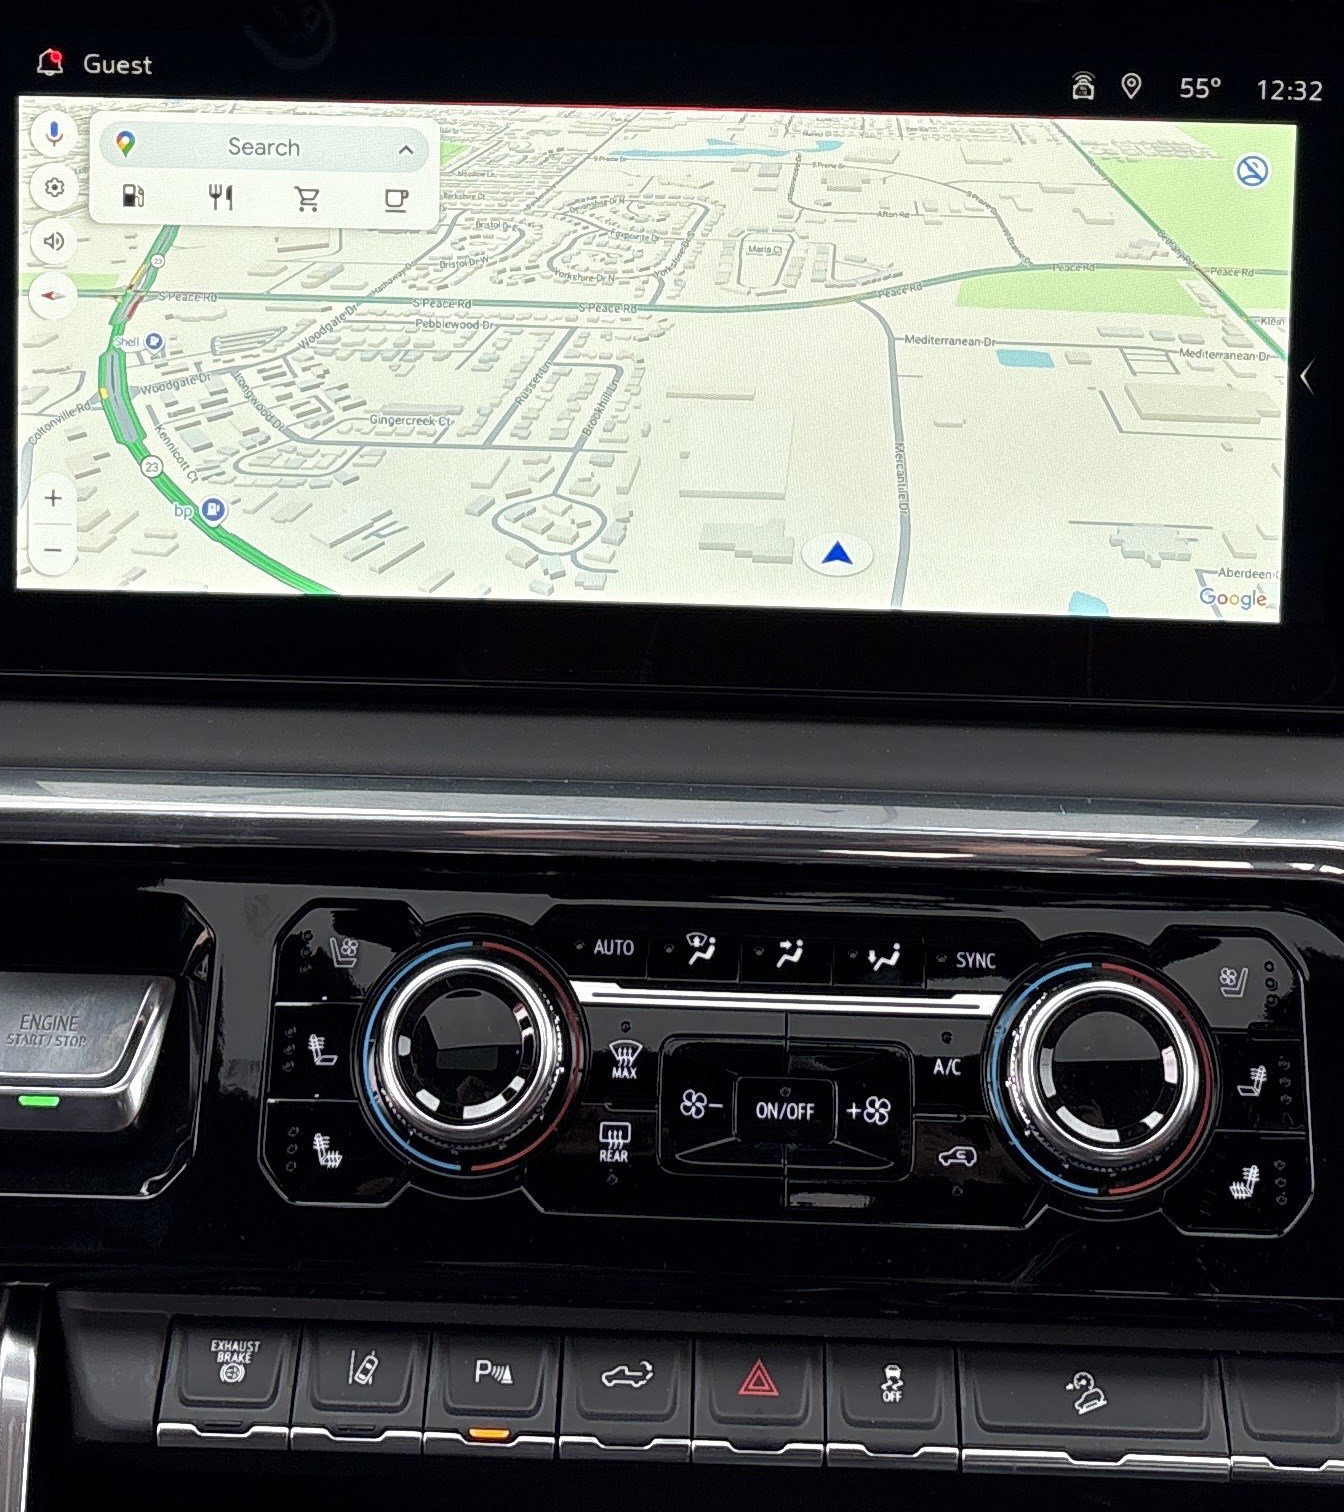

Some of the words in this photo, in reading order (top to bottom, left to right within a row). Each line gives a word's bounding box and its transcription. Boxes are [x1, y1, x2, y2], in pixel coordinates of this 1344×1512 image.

[83, 53, 153, 75] Guest
[1180, 77, 1222, 98] 55°
[1257, 79, 1323, 102] 12:32
[228, 136, 301, 157] Search
[1052, 263, 1082, 272] Peace
[1083, 262, 1096, 272] Rd
[1210, 268, 1240, 277] Peace
[1241, 268, 1255, 277] Rd
[158, 292, 165, 301] S
[168, 292, 200, 302] Peace
[202, 293, 217, 303] Rd
[877, 285, 907, 299] Peace
[908, 282, 923, 292] Rd
[412, 298, 421, 308] S
[422, 298, 455, 309] Peace
[457, 299, 472, 309] Rd
[579, 303, 587, 313] S
[590, 303, 621, 313] Peace
[623, 304, 637, 314] Rd
[297, 314, 346, 350] Woodgate
[344, 303, 358, 316] Dr
[415, 318, 480, 330] Pebblewood
[483, 320, 495, 330] Dr
[1260, 317, 1285, 326] Klein
[114, 337, 140, 347] Shell
[904, 334, 981, 347] Mediterranean
[983, 337, 996, 347] Dr
[1179, 348, 1256, 362] Mediterranean
[1258, 351, 1271, 362] Dr
[140, 375, 197, 396] Woodgate
[198, 373, 212, 384] Dr
[515, 374, 544, 406] Russet
[235, 373, 276, 425] Longwood
[369, 414, 436, 427] Gingercreek
[438, 416, 451, 428] Ct
[582, 389, 614, 436] Brookhill
[28, 409, 76, 447] Coltonville
[76, 401, 92, 414] Rd
[155, 423, 191, 473] Kennicott
[186, 468, 200, 485] Ct
[145, 461, 159, 473] 23
[174, 503, 193, 521] bp
[1218, 567, 1272, 579] Aberdeen
[1199, 587, 1267, 611] Google
[593, 939, 635, 956] AUTO
[956, 952, 997, 970] SYNC
[20, 1013, 79, 1033] ENGINE
[611, 1066, 638, 1080] MAX
[933, 1058, 962, 1077] A/C
[755, 1101, 815, 1120] ON/OFF
[599, 1149, 630, 1164] REAR
[210, 1339, 261, 1354] EXHAUST
[216, 1351, 252, 1365] BRAKE
[882, 1390, 903, 1403] OFF
